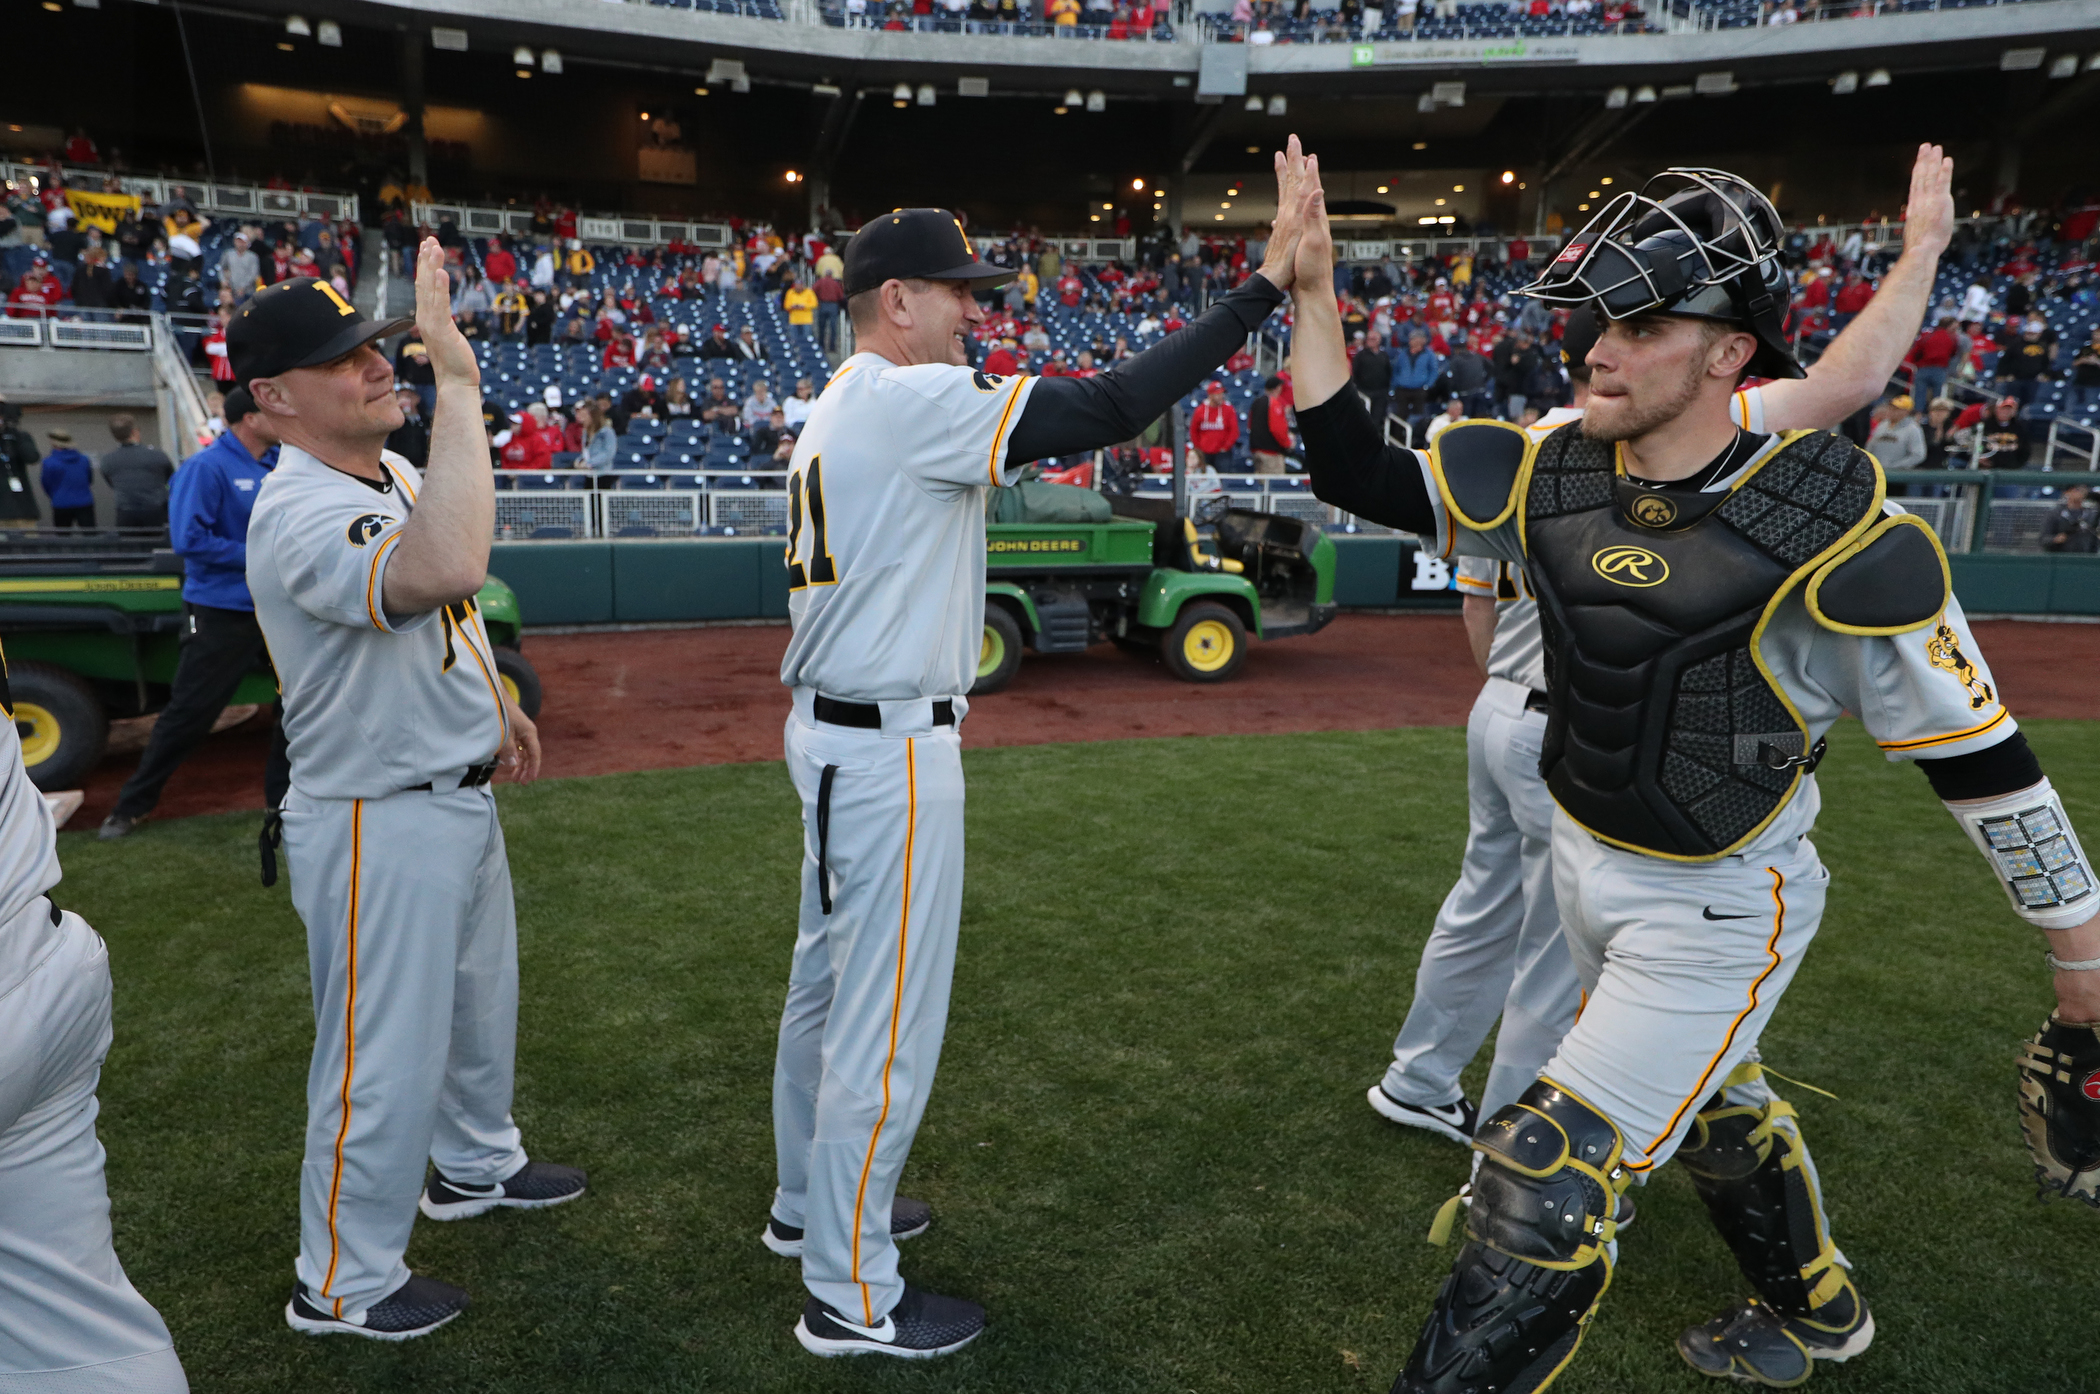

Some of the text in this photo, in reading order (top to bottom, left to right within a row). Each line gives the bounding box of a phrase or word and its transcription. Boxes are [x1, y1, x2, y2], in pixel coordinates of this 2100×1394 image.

[1355, 48, 1372, 63] TD
[312, 280, 356, 317] I
[784, 453, 839, 593] 21
[987, 540, 1080, 552] JOHN DEERE
